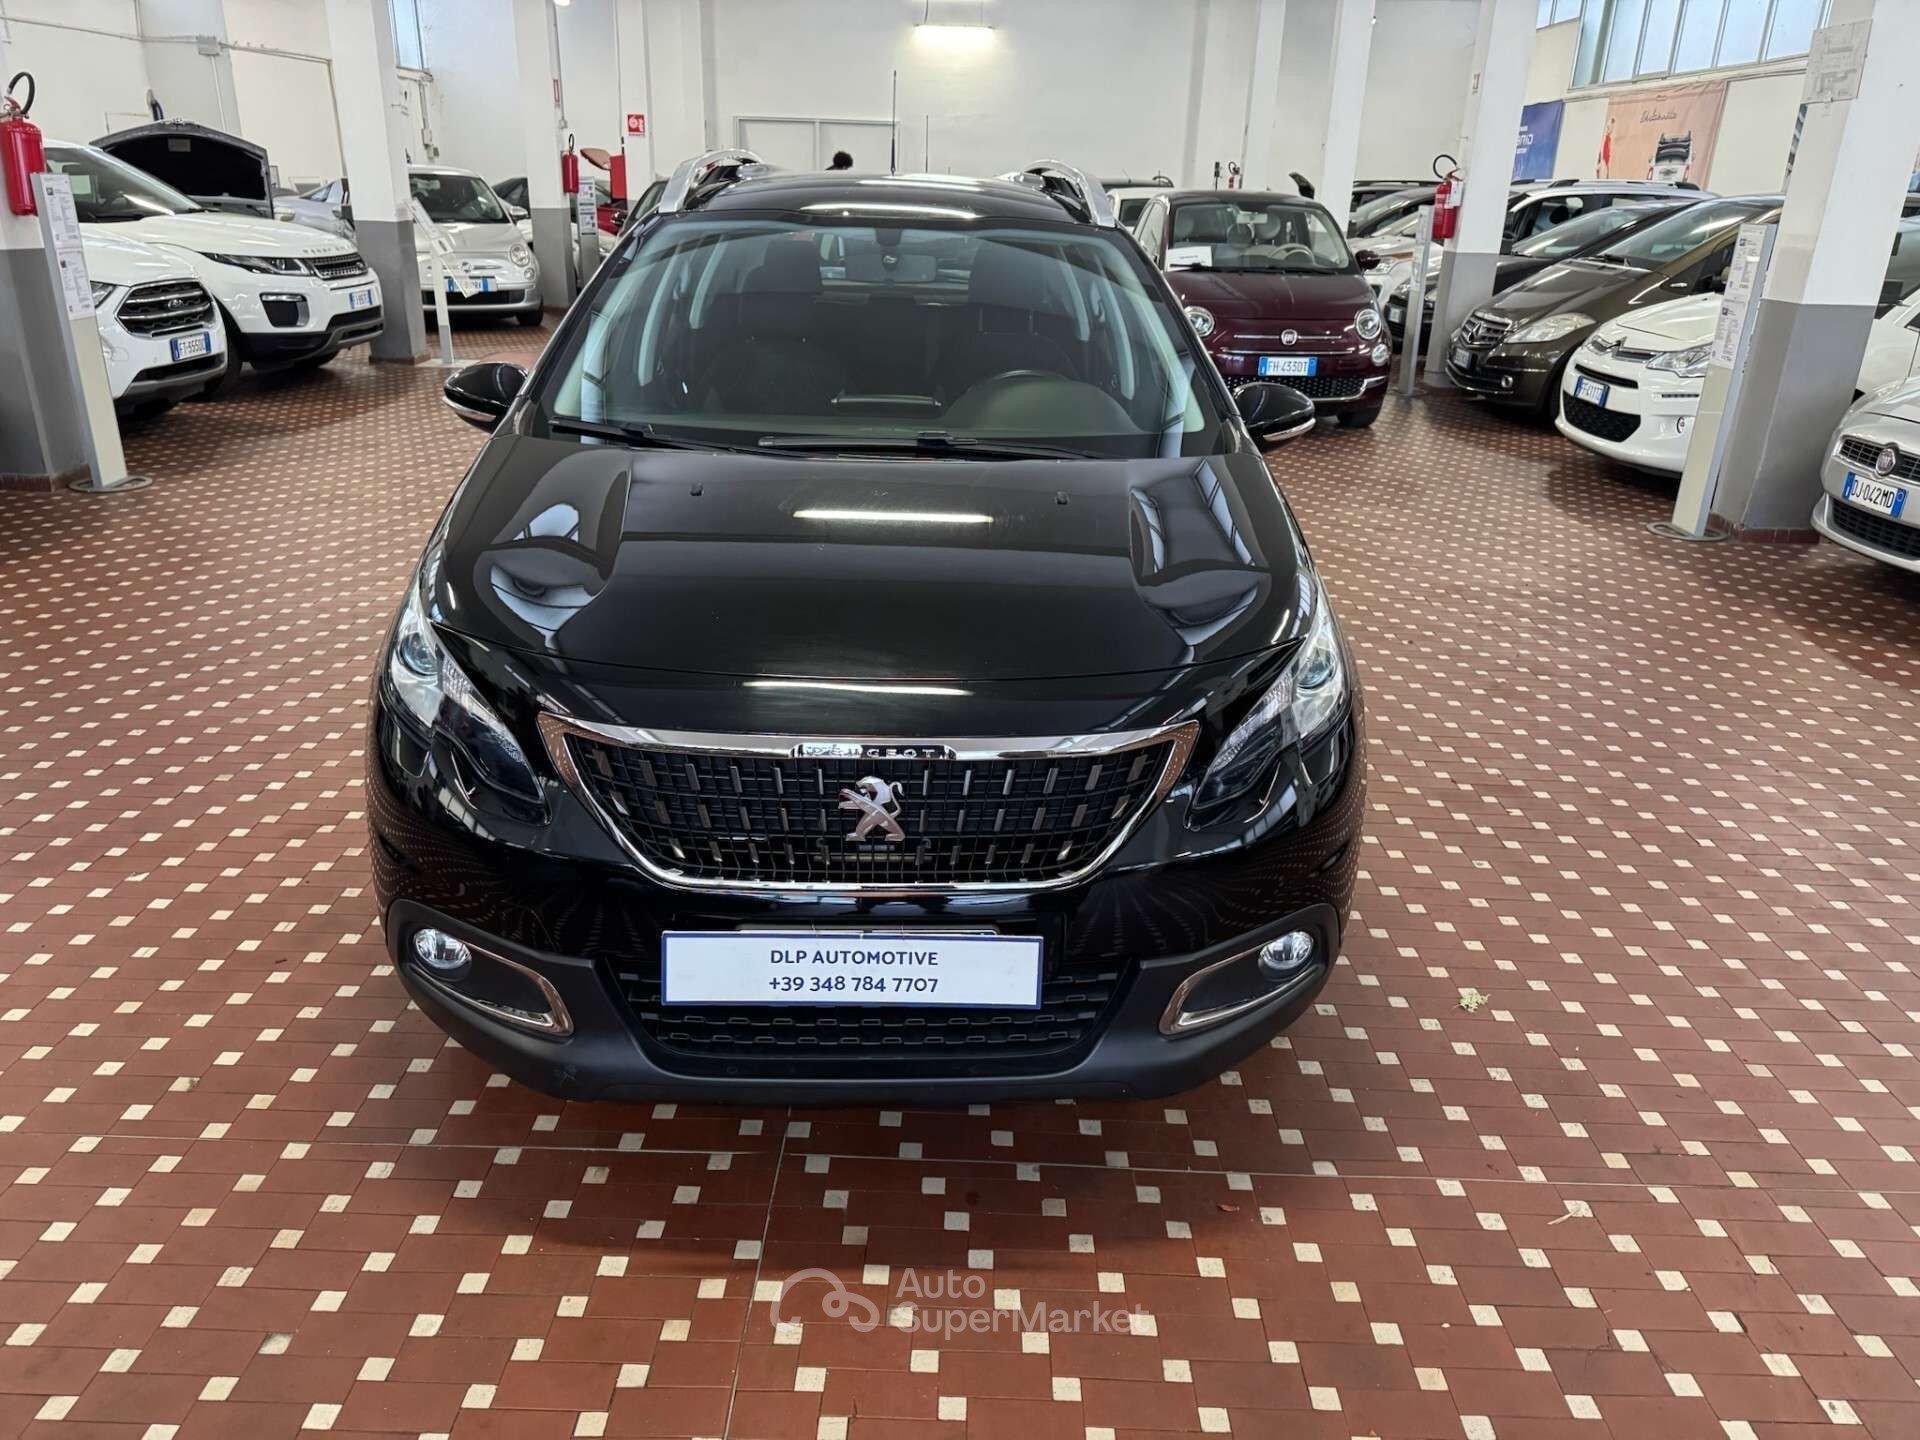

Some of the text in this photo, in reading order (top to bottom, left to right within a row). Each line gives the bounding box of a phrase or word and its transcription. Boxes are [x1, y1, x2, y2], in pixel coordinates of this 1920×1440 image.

[770, 950, 939, 965] DLP AUTOMOTIVE
[769, 975, 938, 992] +39 348 784 7707
